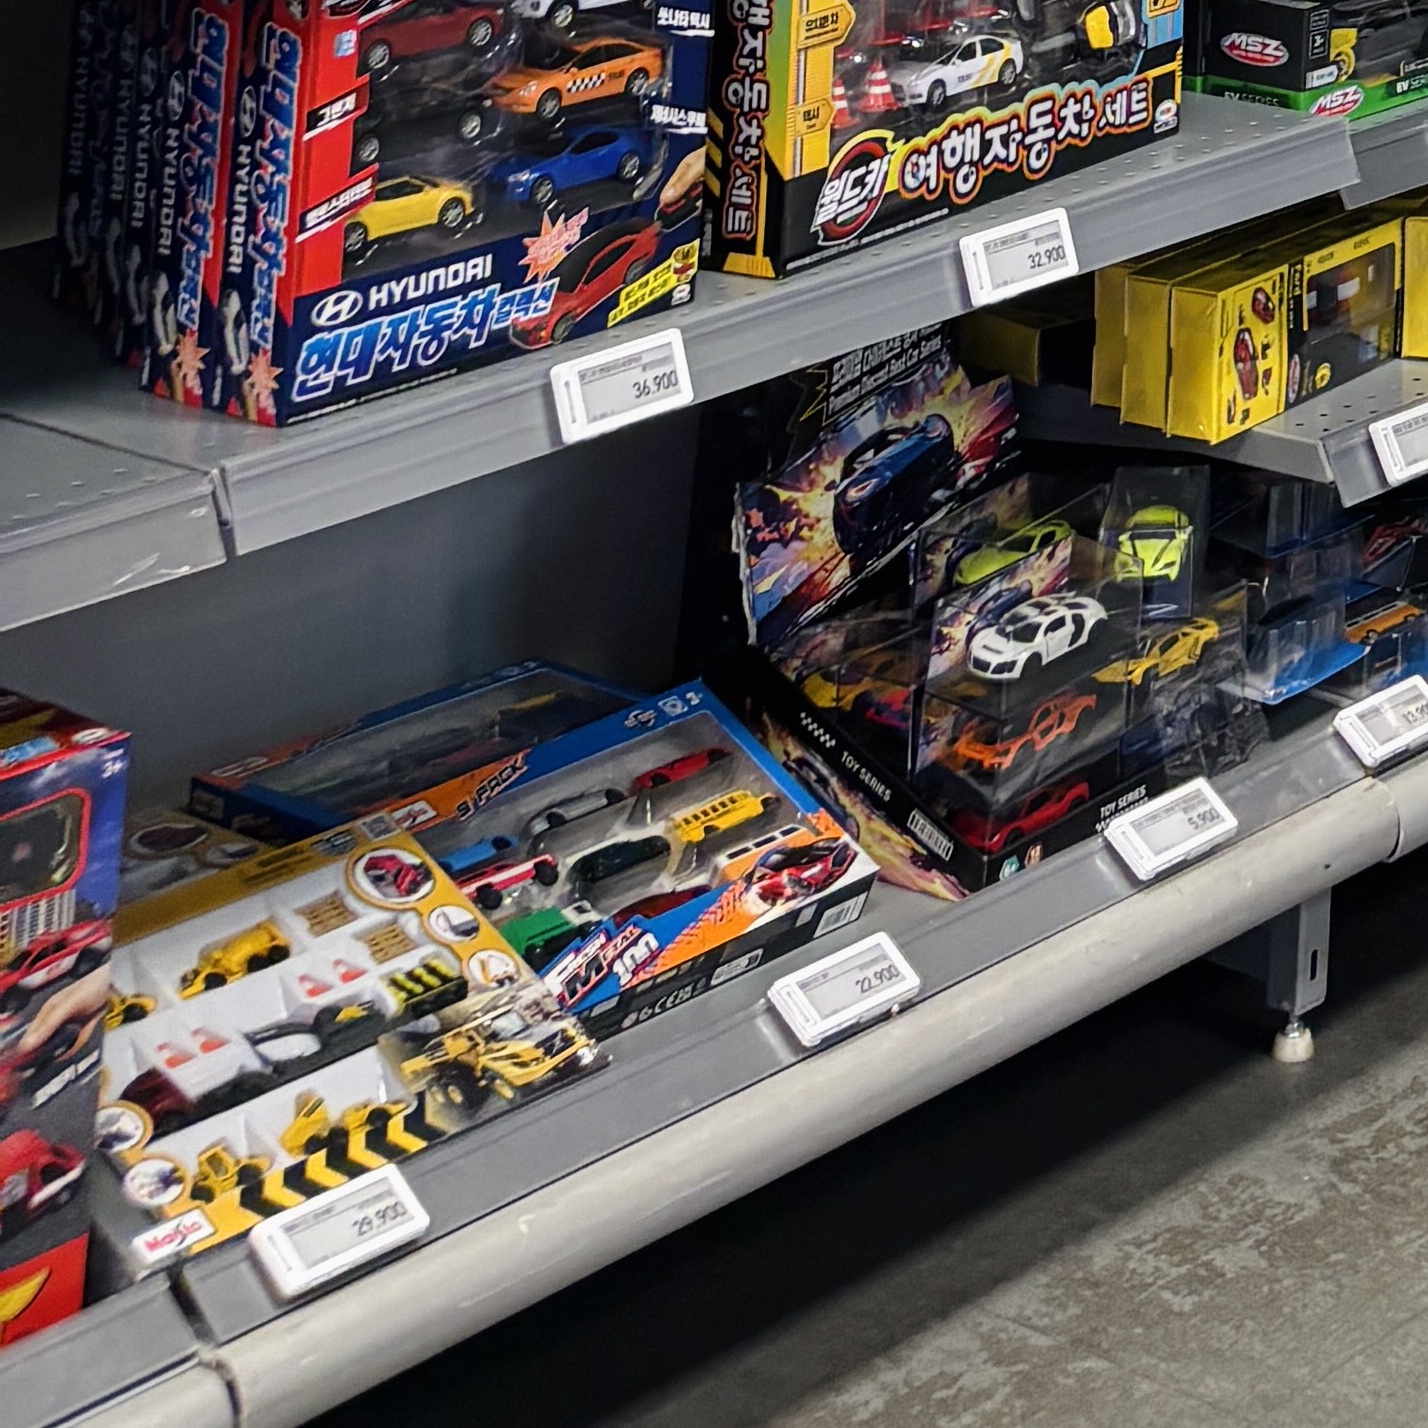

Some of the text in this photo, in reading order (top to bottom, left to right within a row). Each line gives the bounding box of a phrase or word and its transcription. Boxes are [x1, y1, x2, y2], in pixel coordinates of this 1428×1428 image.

[1224, 34, 1285, 57] MSZ
[132, 103, 152, 229] HYUNDAI
[898, 80, 1152, 205] 여행자동차 세트
[157, 127, 179, 256] HYUNDAI
[228, 144, 251, 274] HYUNDAI
[368, 253, 493, 311] HYUNDAI
[1028, 246, 1065, 268] 32.900
[292, 282, 502, 403] 현대자동차
[633, 371, 678, 398] 36.900
[840, 751, 894, 803] TOY SERIES
[859, 963, 901, 994] 22.900
[350, 1200, 408, 1240] 29.900
